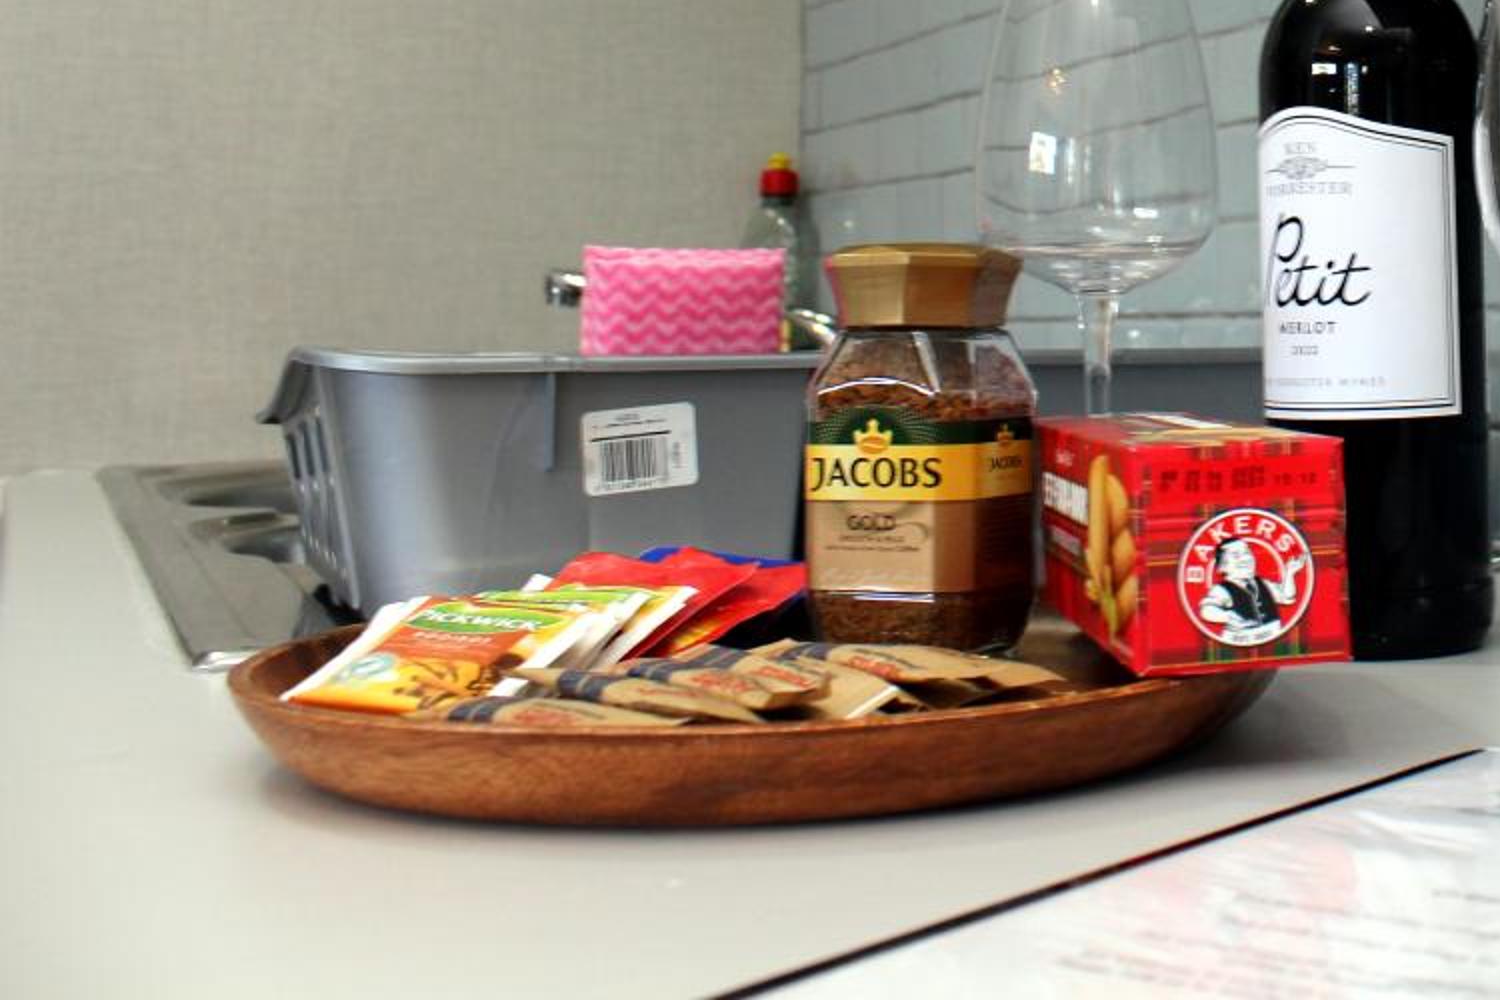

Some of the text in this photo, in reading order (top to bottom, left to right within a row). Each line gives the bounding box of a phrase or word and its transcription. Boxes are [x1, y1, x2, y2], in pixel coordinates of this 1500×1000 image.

[1266, 212, 1373, 309] Petit
[1278, 320, 1338, 335] MERLOT
[811, 457, 942, 492] JACOBS
[846, 514, 896, 531] GOLD
[1185, 515, 1296, 583] BAKERS
[420, 607, 542, 631] PICKWICK
